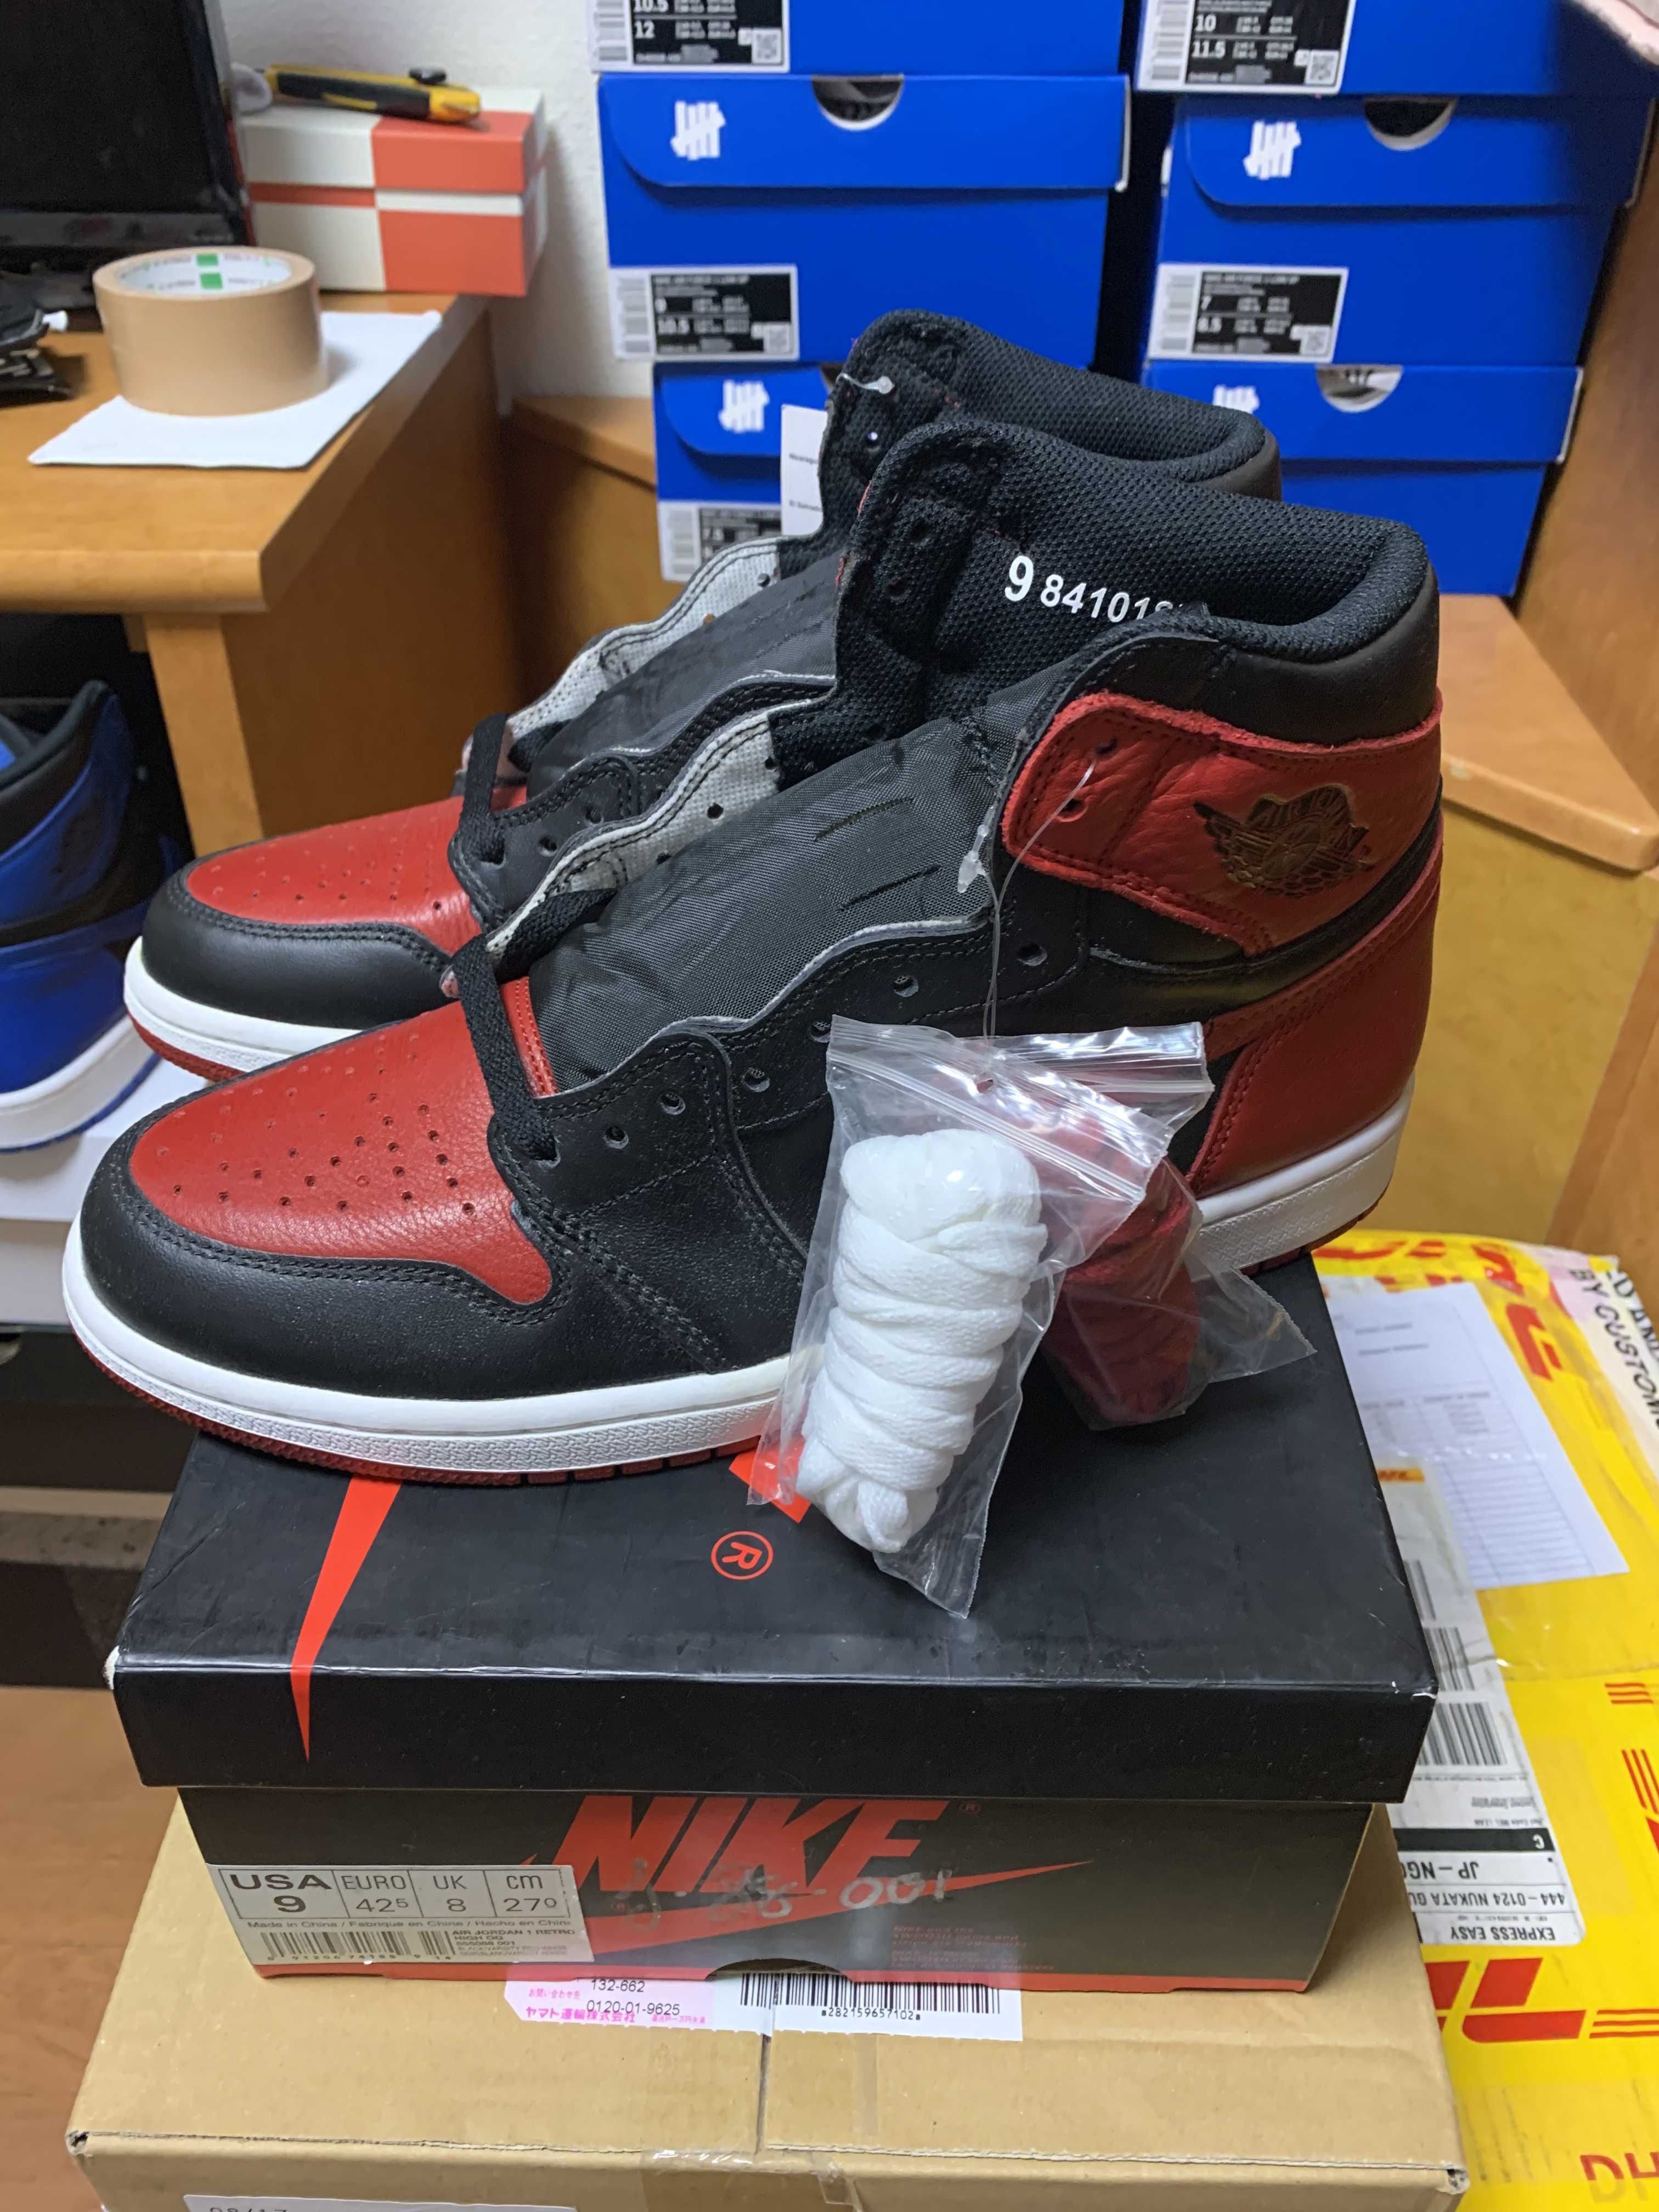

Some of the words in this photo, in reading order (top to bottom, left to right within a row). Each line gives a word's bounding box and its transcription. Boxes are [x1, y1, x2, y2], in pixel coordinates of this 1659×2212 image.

[634, 20, 656, 39] 12
[1195, 14, 1216, 32] 10
[1005, 555, 1034, 602] 9
[1040, 574, 1183, 623] 84101
[1569, 1268, 1610, 1299] BY
[1594, 1302, 1659, 1430] CUSTOM
[551, 1795, 949, 1893] NIKE
[229, 1874, 332, 1890] USA
[341, 1875, 407, 1890] EURO
[433, 1875, 467, 1890] UK
[273, 1895, 306, 1913] 9
[447, 1898, 467, 1912] 8
[1431, 1893, 1489, 1906] NUKATA
[1451, 1926, 1486, 1940] EASY
[1490, 1926, 1555, 1940] EXPRESS
[591, 1979, 646, 1993] 132-662
[586, 2000, 680, 2016] 0120-01-9625
